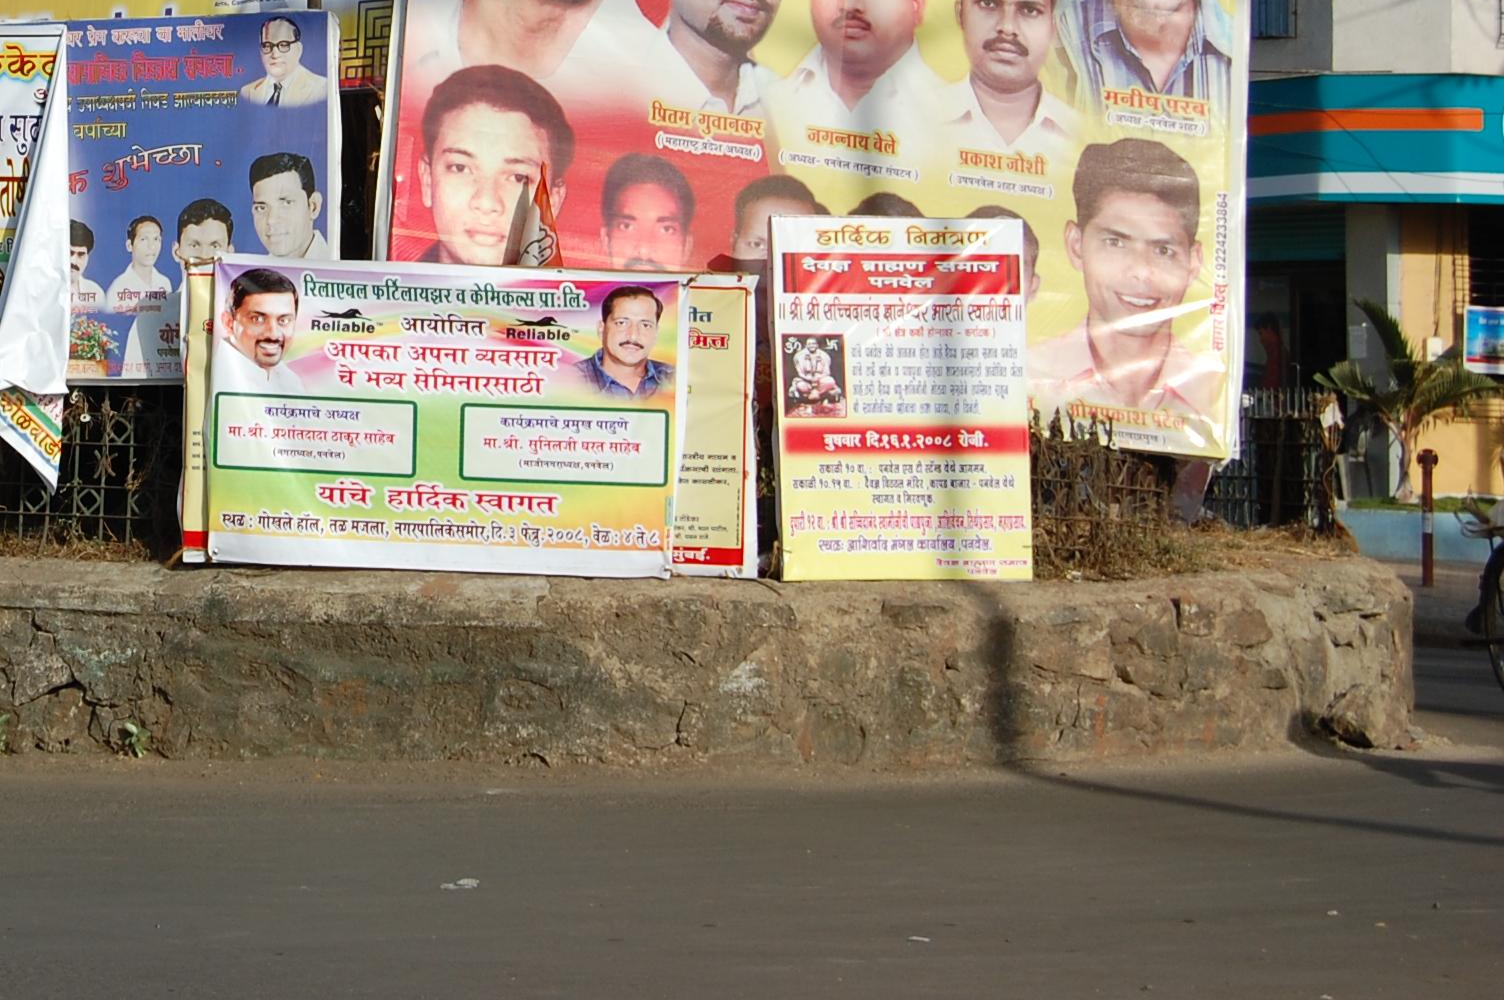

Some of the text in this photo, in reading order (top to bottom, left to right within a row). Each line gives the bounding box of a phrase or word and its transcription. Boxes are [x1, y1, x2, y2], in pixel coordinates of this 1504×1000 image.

[816, 225, 891, 247] हार्दिक
[935, 259, 1000, 273] समाज
[456, 289, 466, 305] व
[401, 313, 486, 335] आयोजित
[328, 341, 557, 366] आपका अपना व्यवसाय
[338, 365, 543, 395] चे भव्य सेमिनारसाठी
[318, 481, 559, 513] यांचे हार्दिक स्वागत
